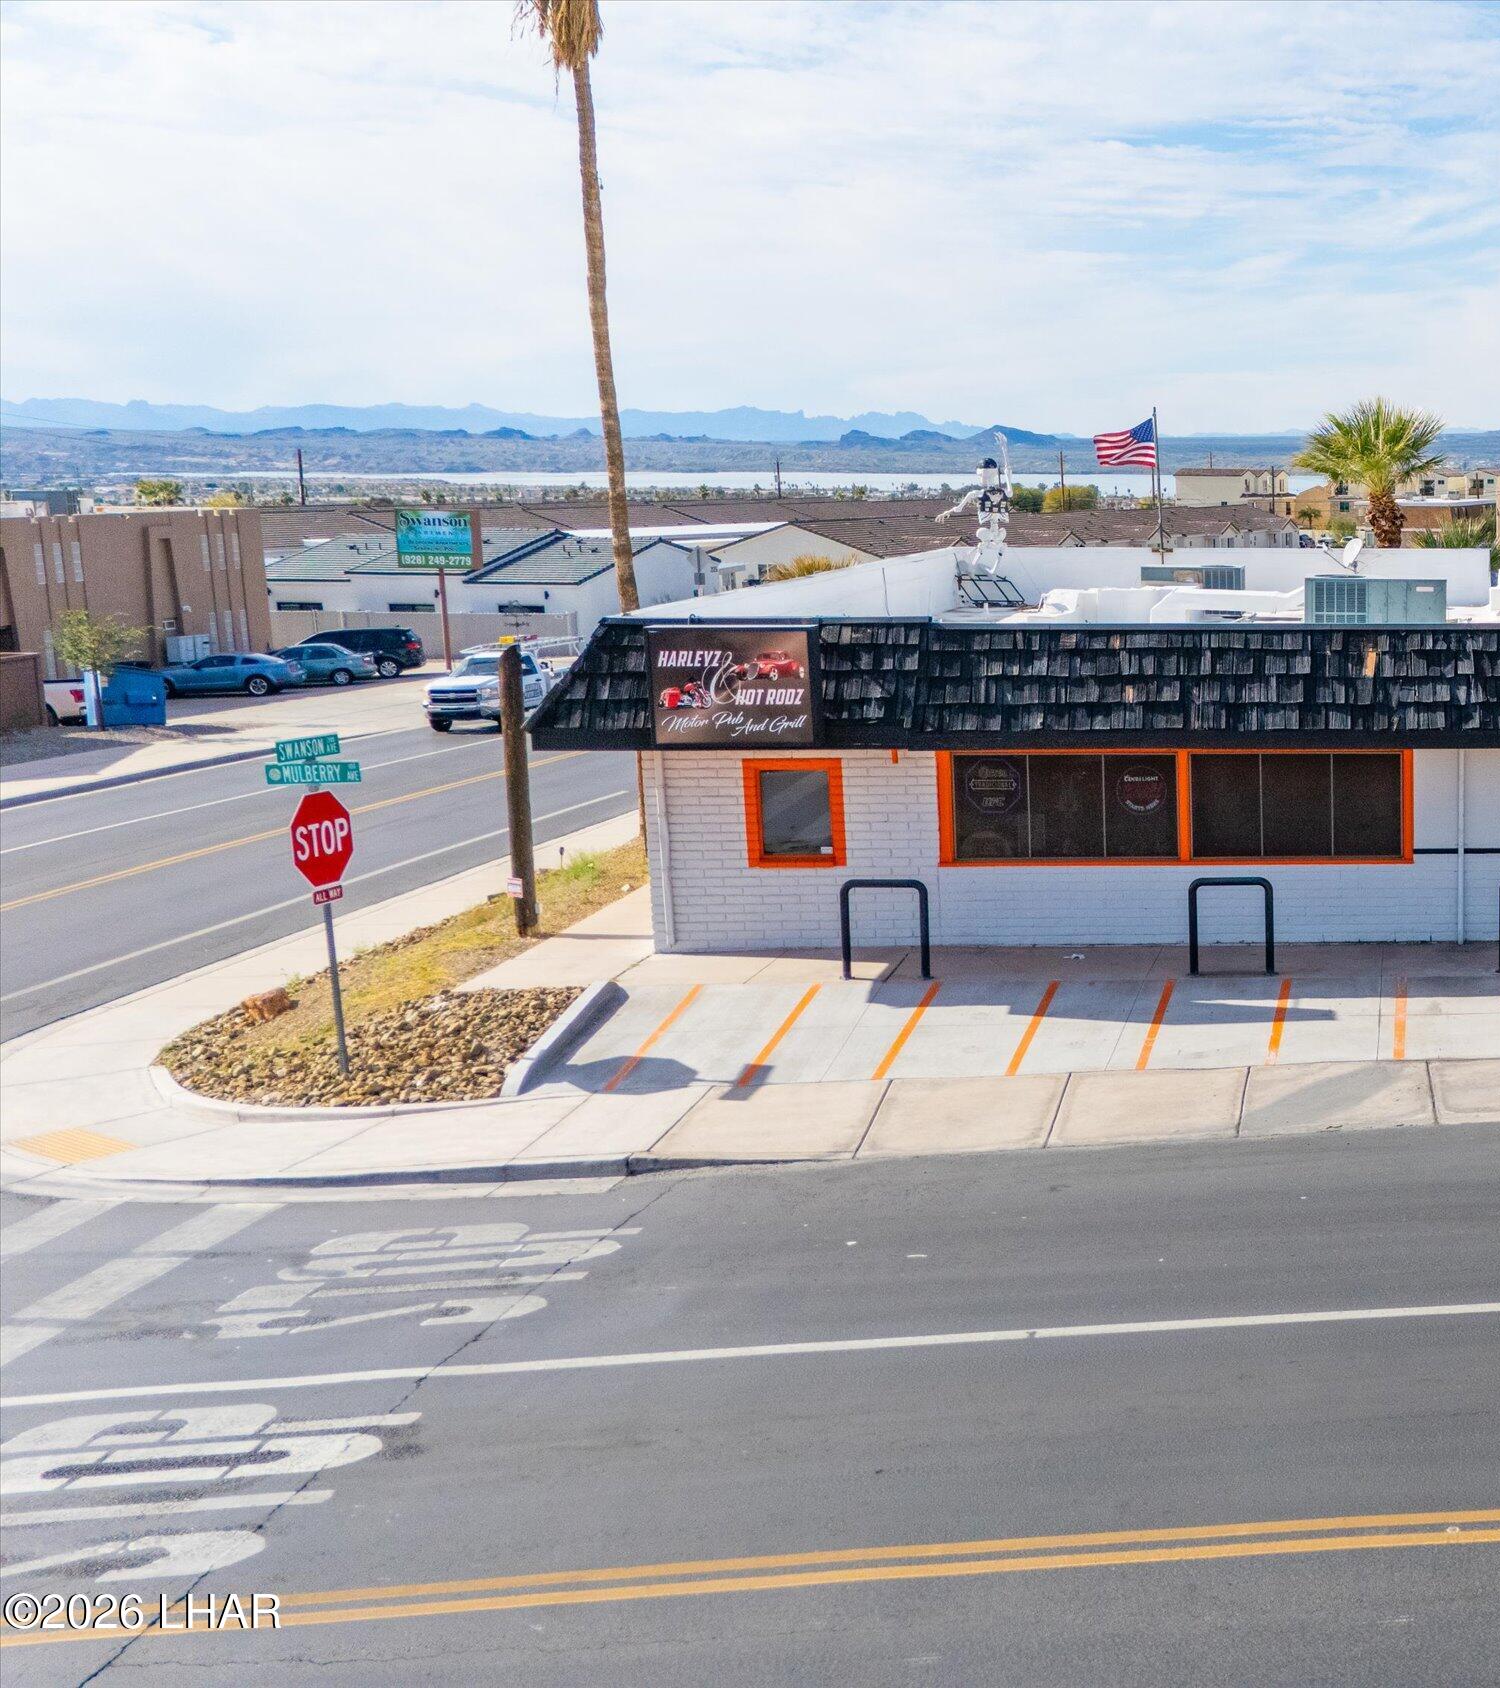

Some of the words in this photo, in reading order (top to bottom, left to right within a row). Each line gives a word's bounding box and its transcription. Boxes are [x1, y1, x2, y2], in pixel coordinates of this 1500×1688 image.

[400, 513, 467, 527] Swanson
[401, 555, 426, 565] (928)
[657, 650, 722, 667] HARLEYZ
[734, 689, 764, 705] HOT
[765, 688, 805, 705] RODZ
[661, 714, 709, 734] Motor
[711, 711, 744, 730] Pub
[731, 719, 769, 737] And
[769, 714, 808, 735] Grill
[278, 738, 325, 761] SWANSON
[326, 742, 338, 753] AVE
[282, 764, 341, 783] MULBERRY
[346, 770, 360, 781] AVE
[295, 817, 349, 862] STOP
[315, 891, 327, 902] ALL
[328, 887, 342, 898] WAY
